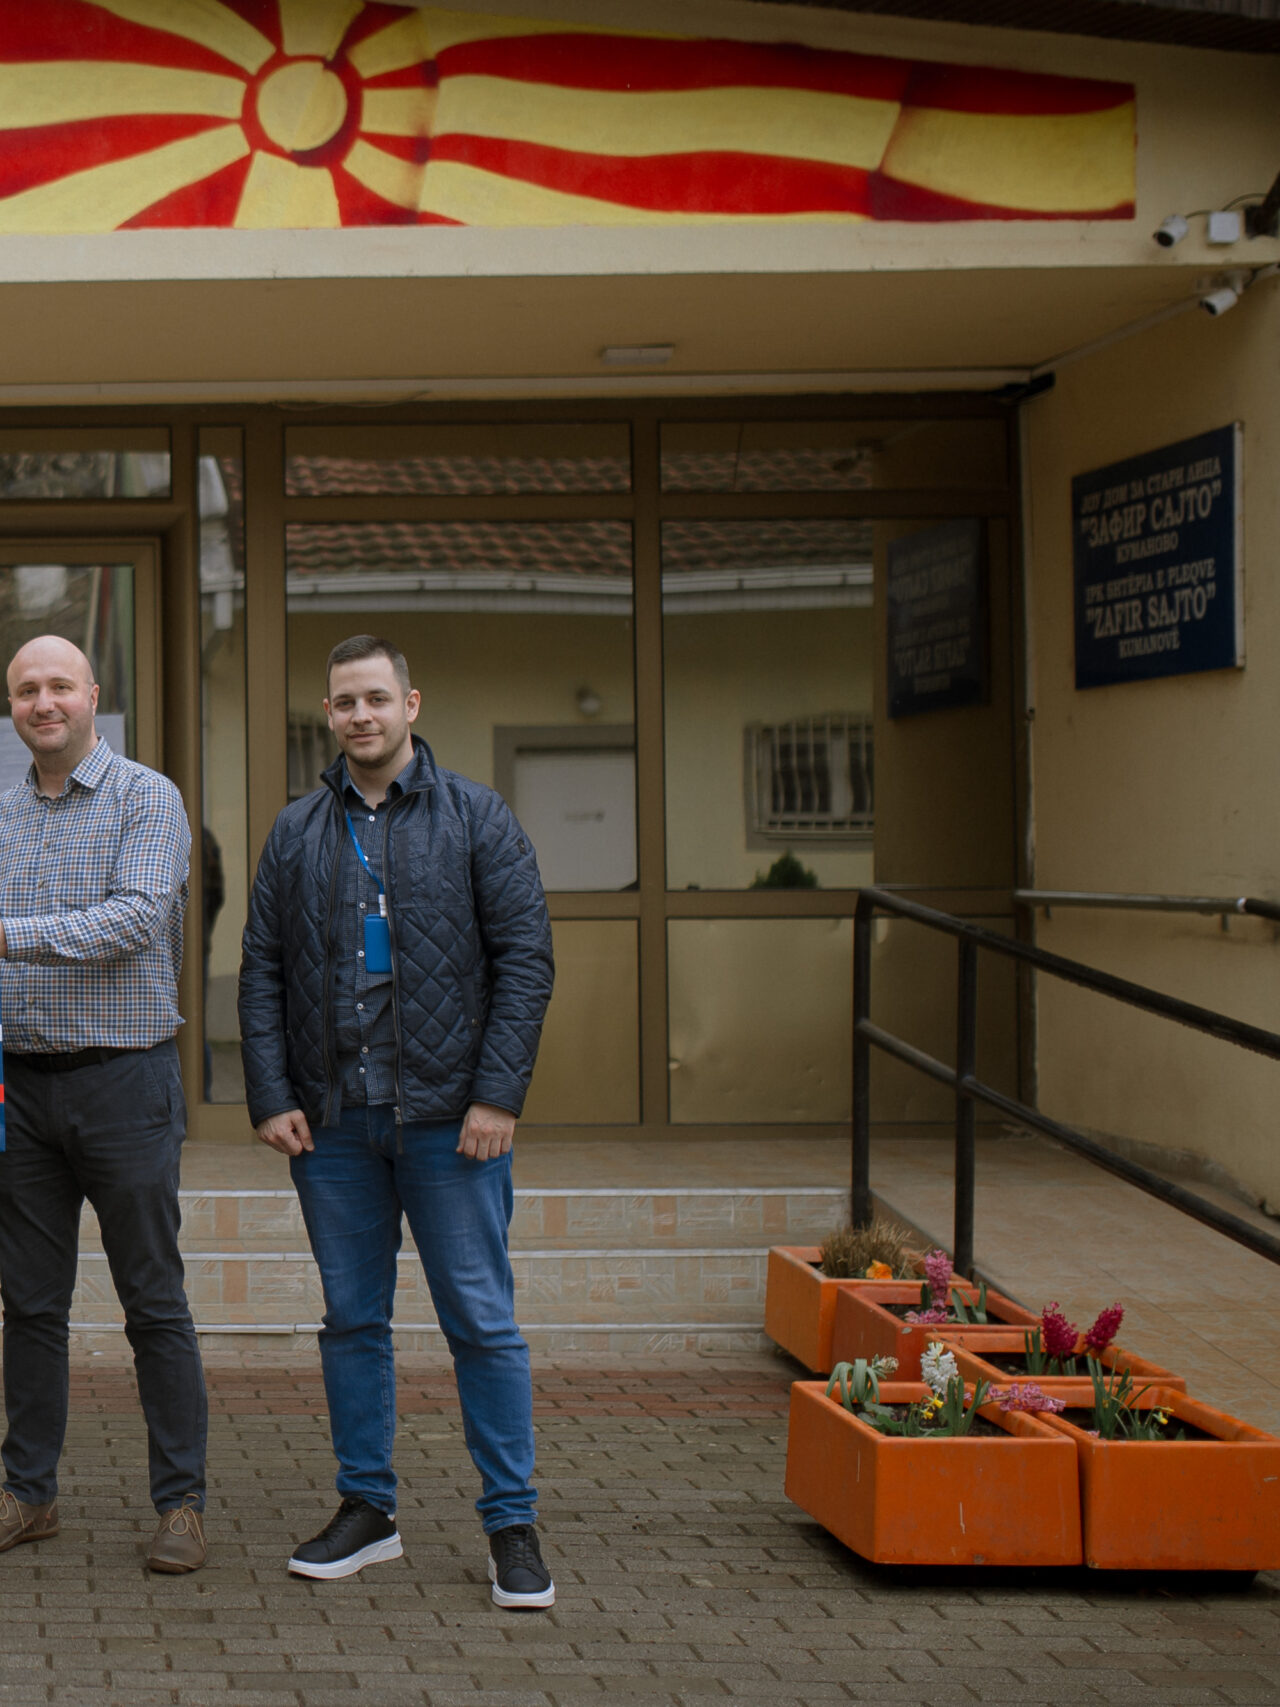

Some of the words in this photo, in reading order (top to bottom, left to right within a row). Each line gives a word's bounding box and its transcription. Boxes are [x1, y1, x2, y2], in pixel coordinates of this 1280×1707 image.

[1103, 483, 1128, 509] ДОМ
[1130, 479, 1145, 500] ЗА
[1147, 466, 1185, 495] СТАРИ
[1116, 531, 1179, 564] КУМАНОВО
[1156, 568, 1165, 590] E
[1168, 557, 1216, 586] PLEQVE
